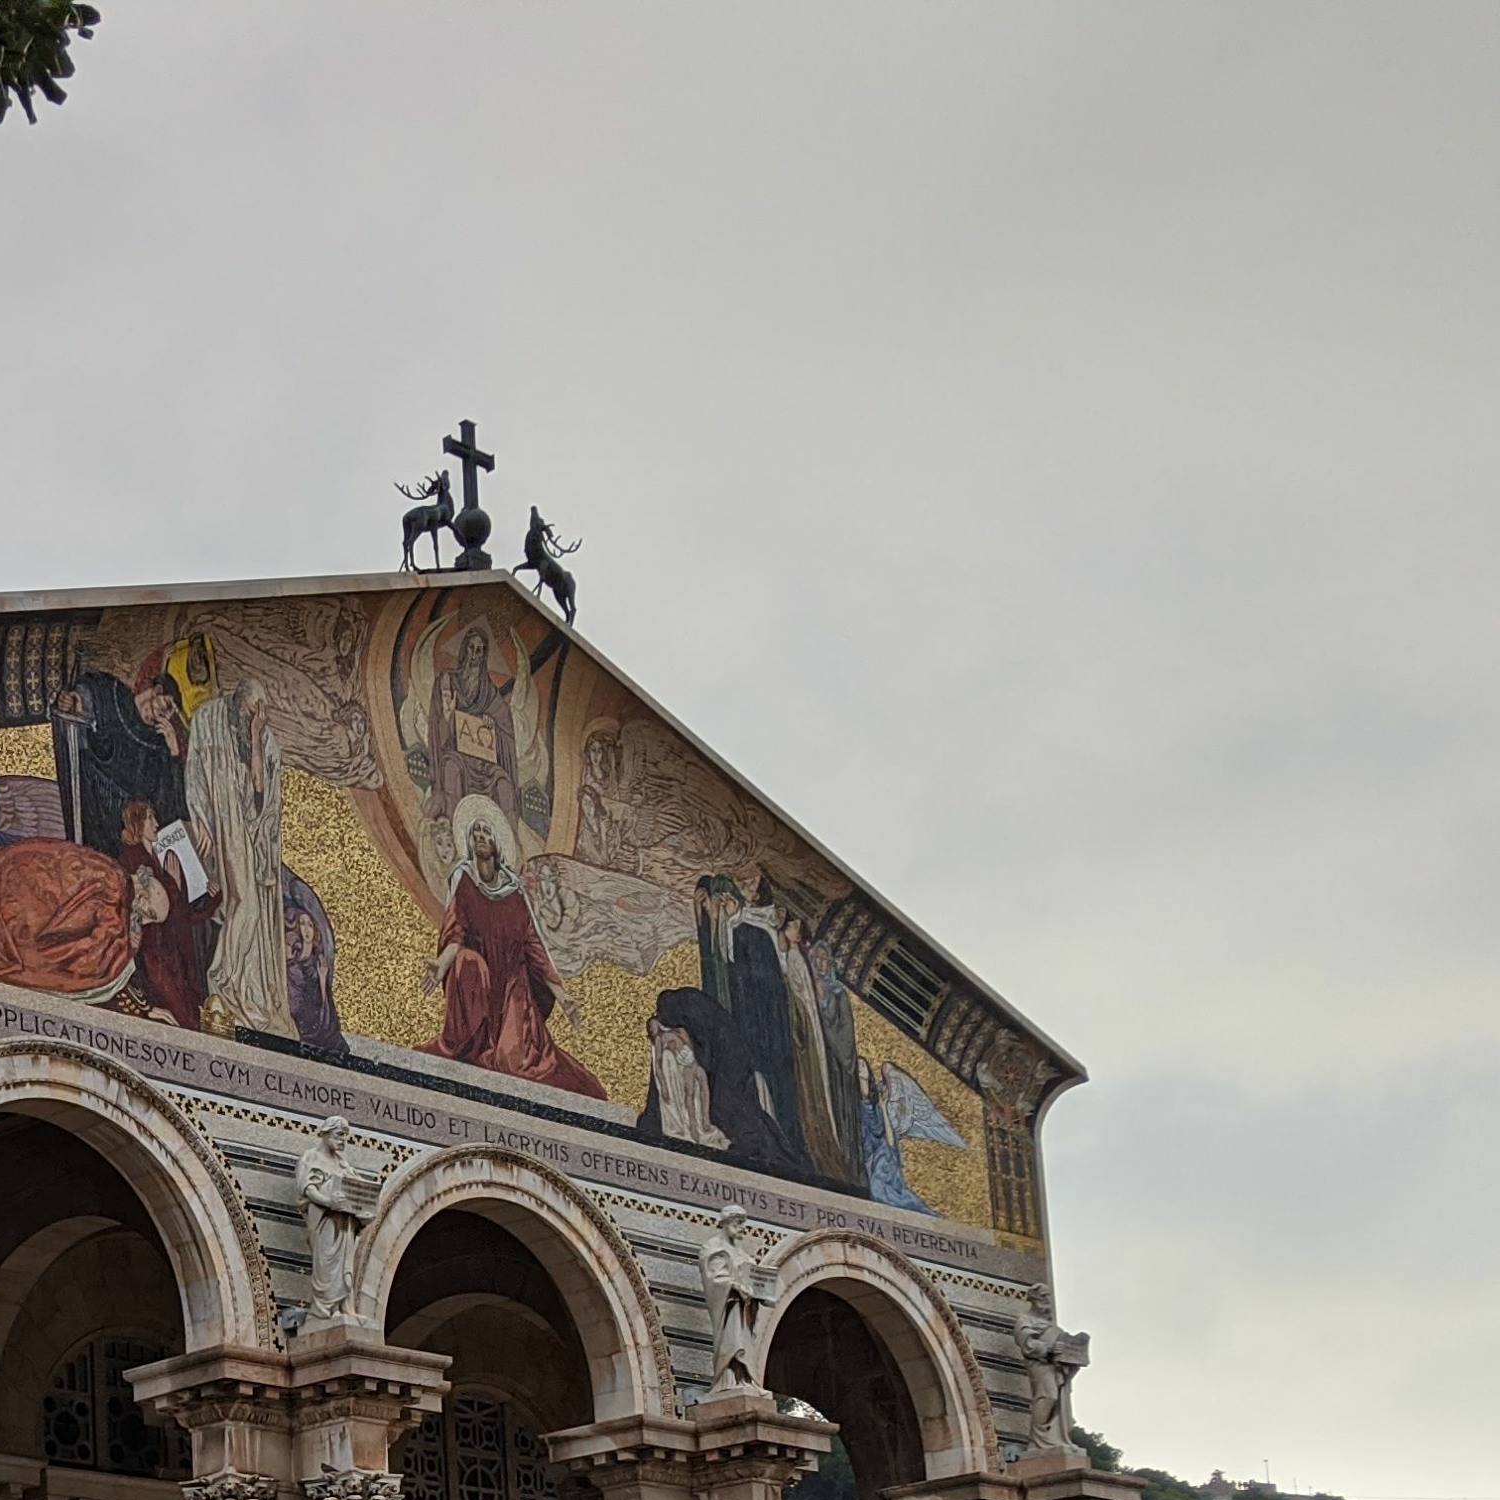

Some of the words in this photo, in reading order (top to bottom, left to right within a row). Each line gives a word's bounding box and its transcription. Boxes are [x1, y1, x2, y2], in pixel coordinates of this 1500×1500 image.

[209, 1060, 250, 1086] CVM
[264, 1073, 355, 1110] CLAMORE
[369, 1098, 436, 1129] VALIDO
[449, 1117, 470, 1138] ET
[484, 1126, 569, 1162] LACRYMIS
[581, 1151, 669, 1186] OFFERENS
[680, 1174, 768, 1210] EXAVDITVS
[778, 1199, 806, 1220] EST
[817, 1209, 847, 1228] PRO
[858, 1218, 885, 1239] SVA
[893, 1226, 978, 1259] REVERENTIA
